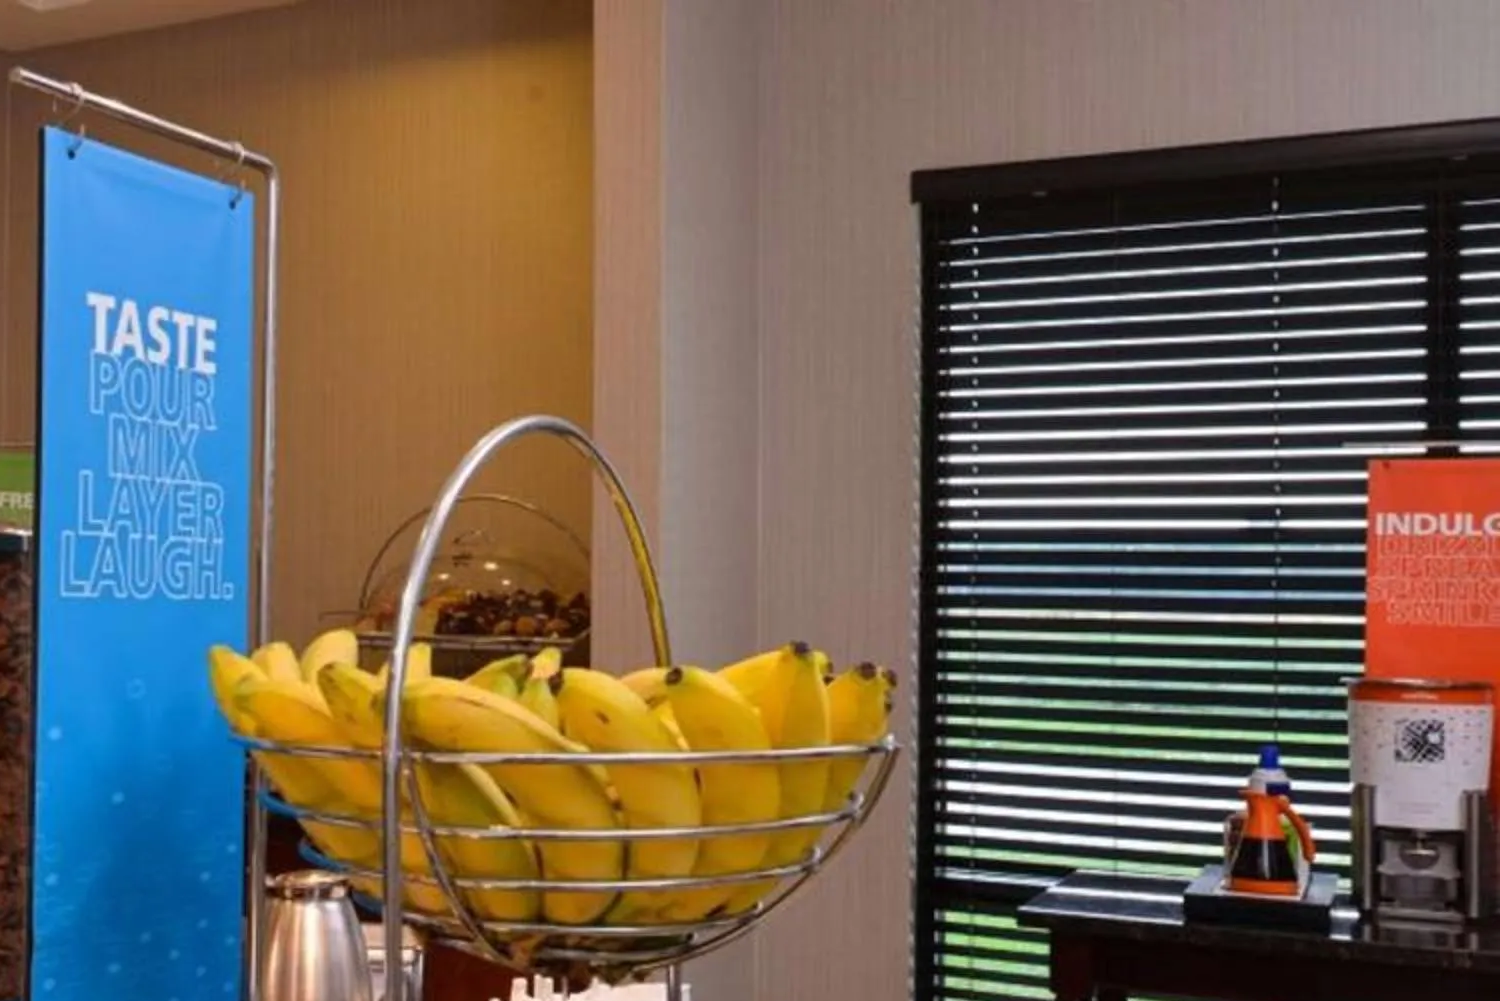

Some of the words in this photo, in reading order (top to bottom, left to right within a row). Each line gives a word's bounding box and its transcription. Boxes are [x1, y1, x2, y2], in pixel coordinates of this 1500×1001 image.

[86, 292, 217, 374] TASTE
[89, 350, 216, 430] POUR
[108, 413, 200, 484] MIX
[78, 470, 225, 543] LAYER
[1375, 512, 1500, 537] INDULG
[60, 530, 234, 599] LAUGH.
